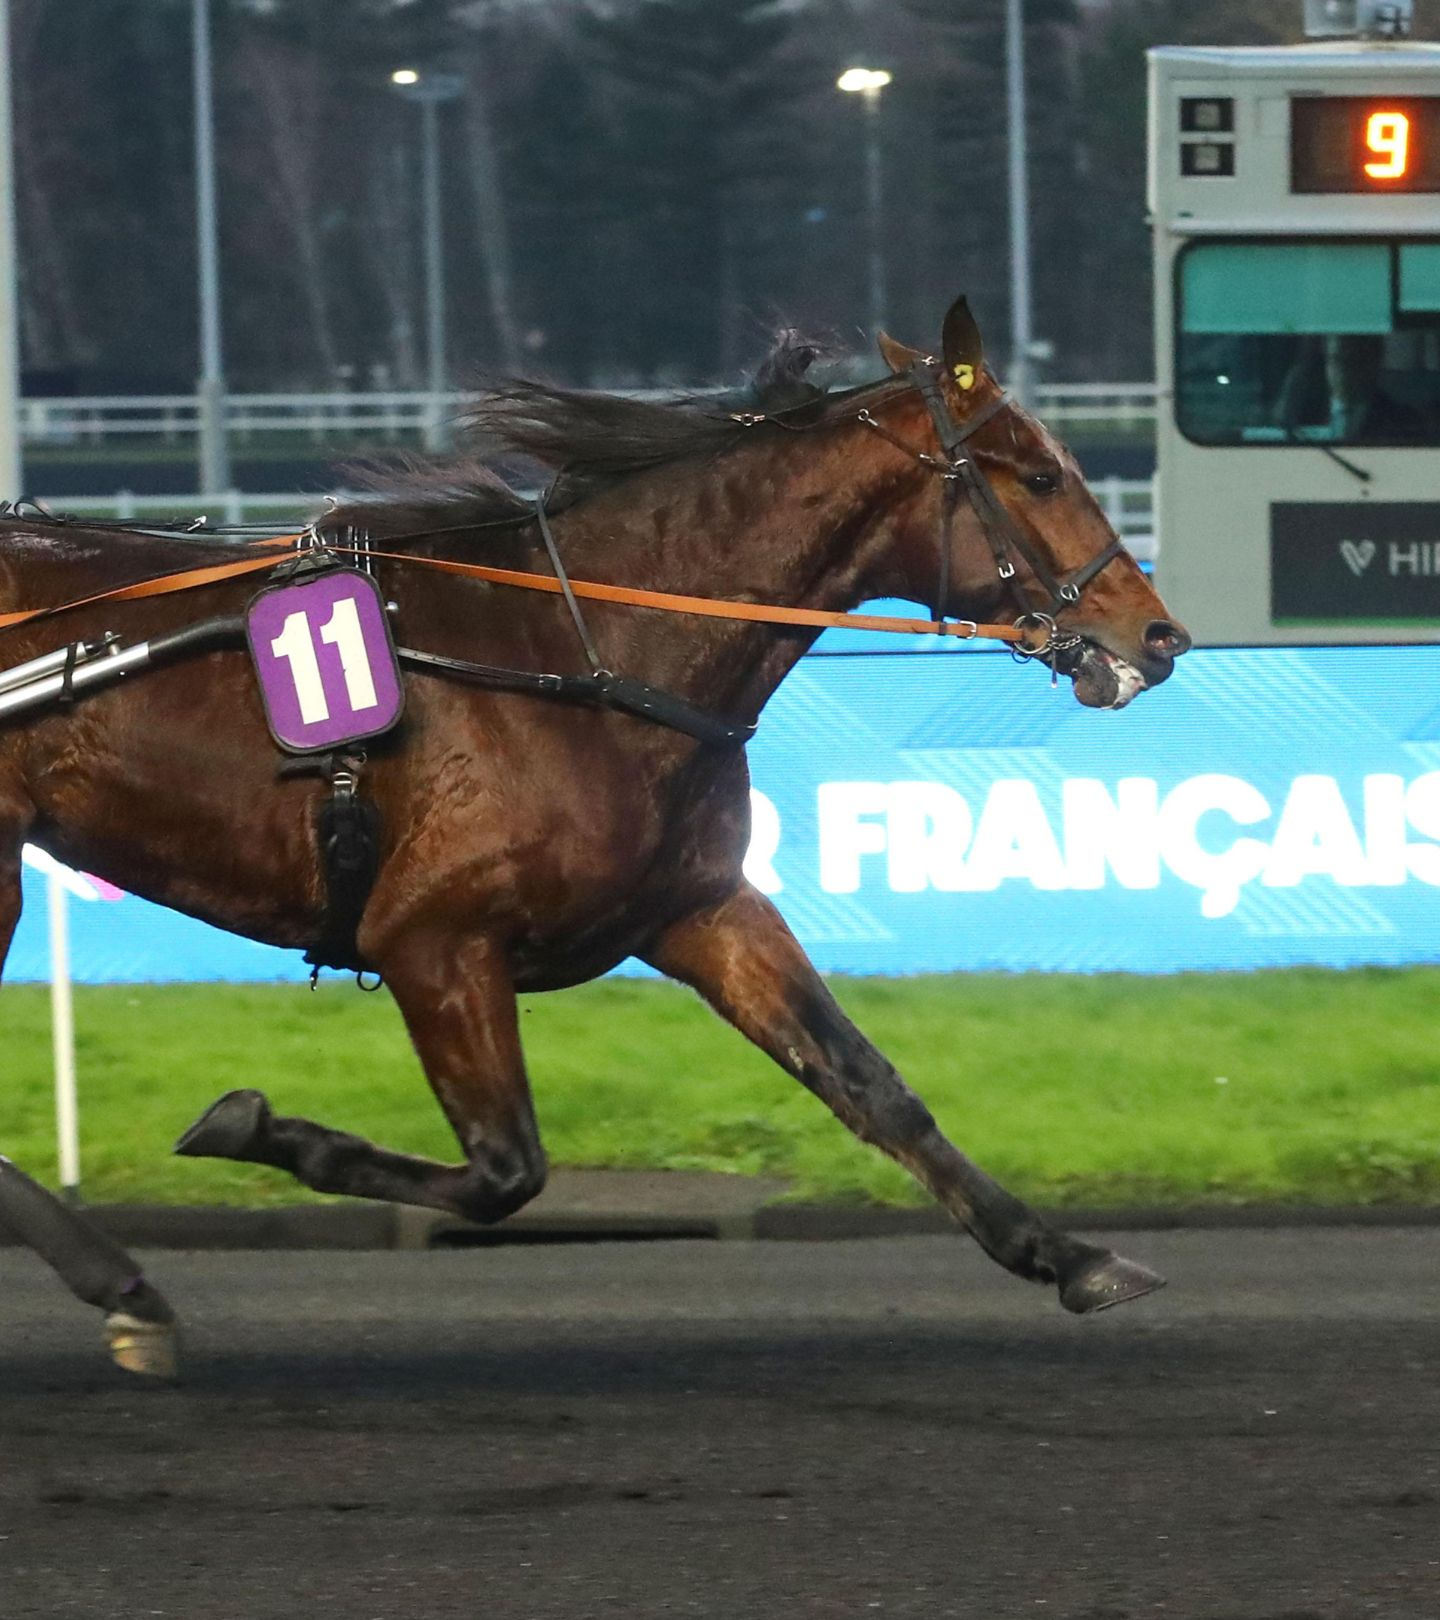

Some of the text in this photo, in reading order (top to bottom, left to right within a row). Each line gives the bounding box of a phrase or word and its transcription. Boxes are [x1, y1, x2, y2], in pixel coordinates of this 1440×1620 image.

[1364, 112, 1409, 178] 9
[1388, 541, 1440, 577] HI
[271, 597, 378, 725] 11
